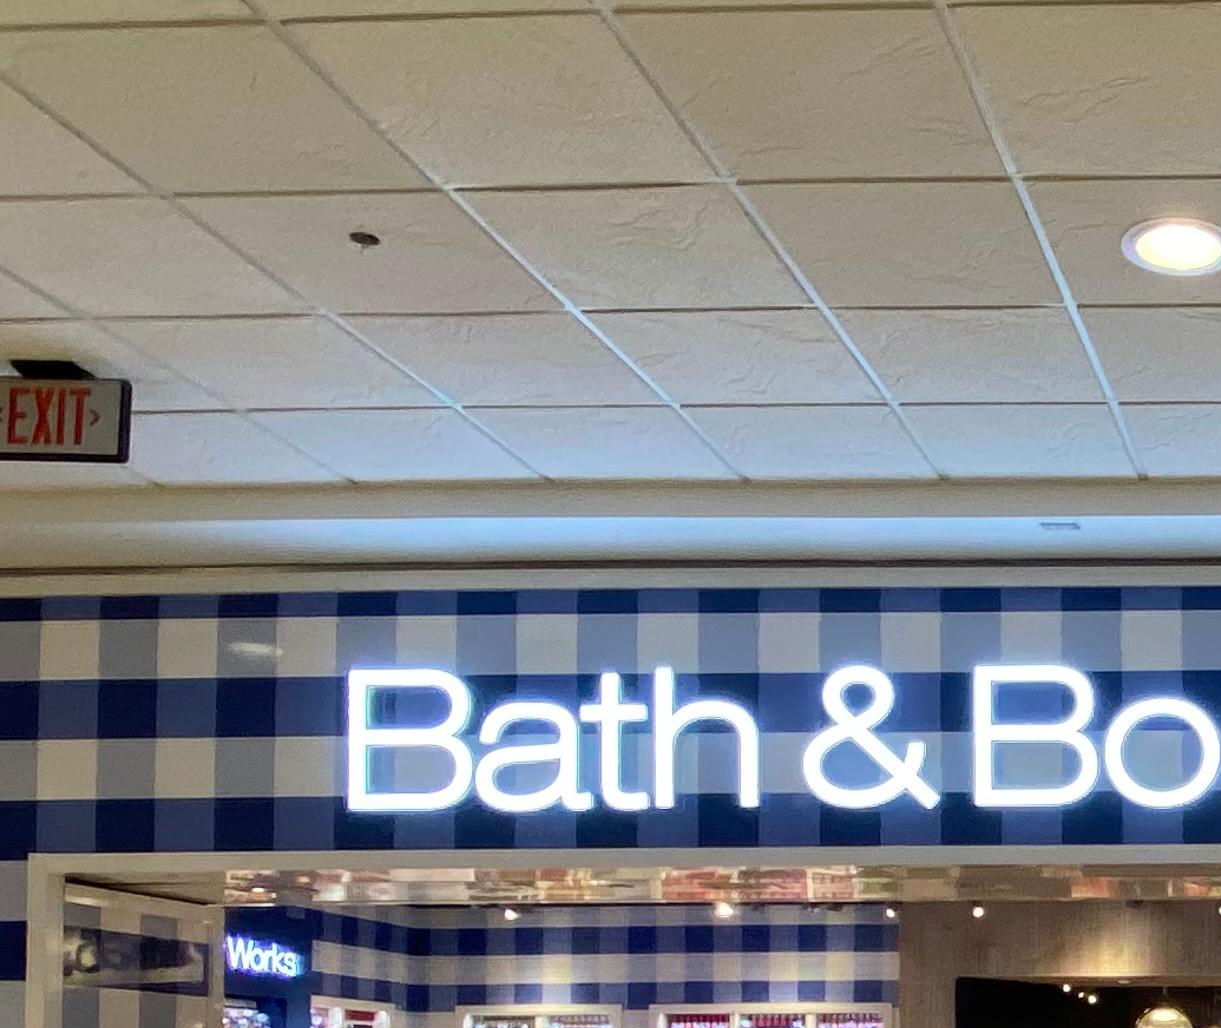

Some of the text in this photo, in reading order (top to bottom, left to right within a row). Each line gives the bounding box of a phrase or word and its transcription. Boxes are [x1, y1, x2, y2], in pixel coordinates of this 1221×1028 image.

[7, 386, 92, 446] EXIT
[346, 666, 759, 812] Bath
[802, 665, 940, 811] &
[225, 934, 298, 978] Works
